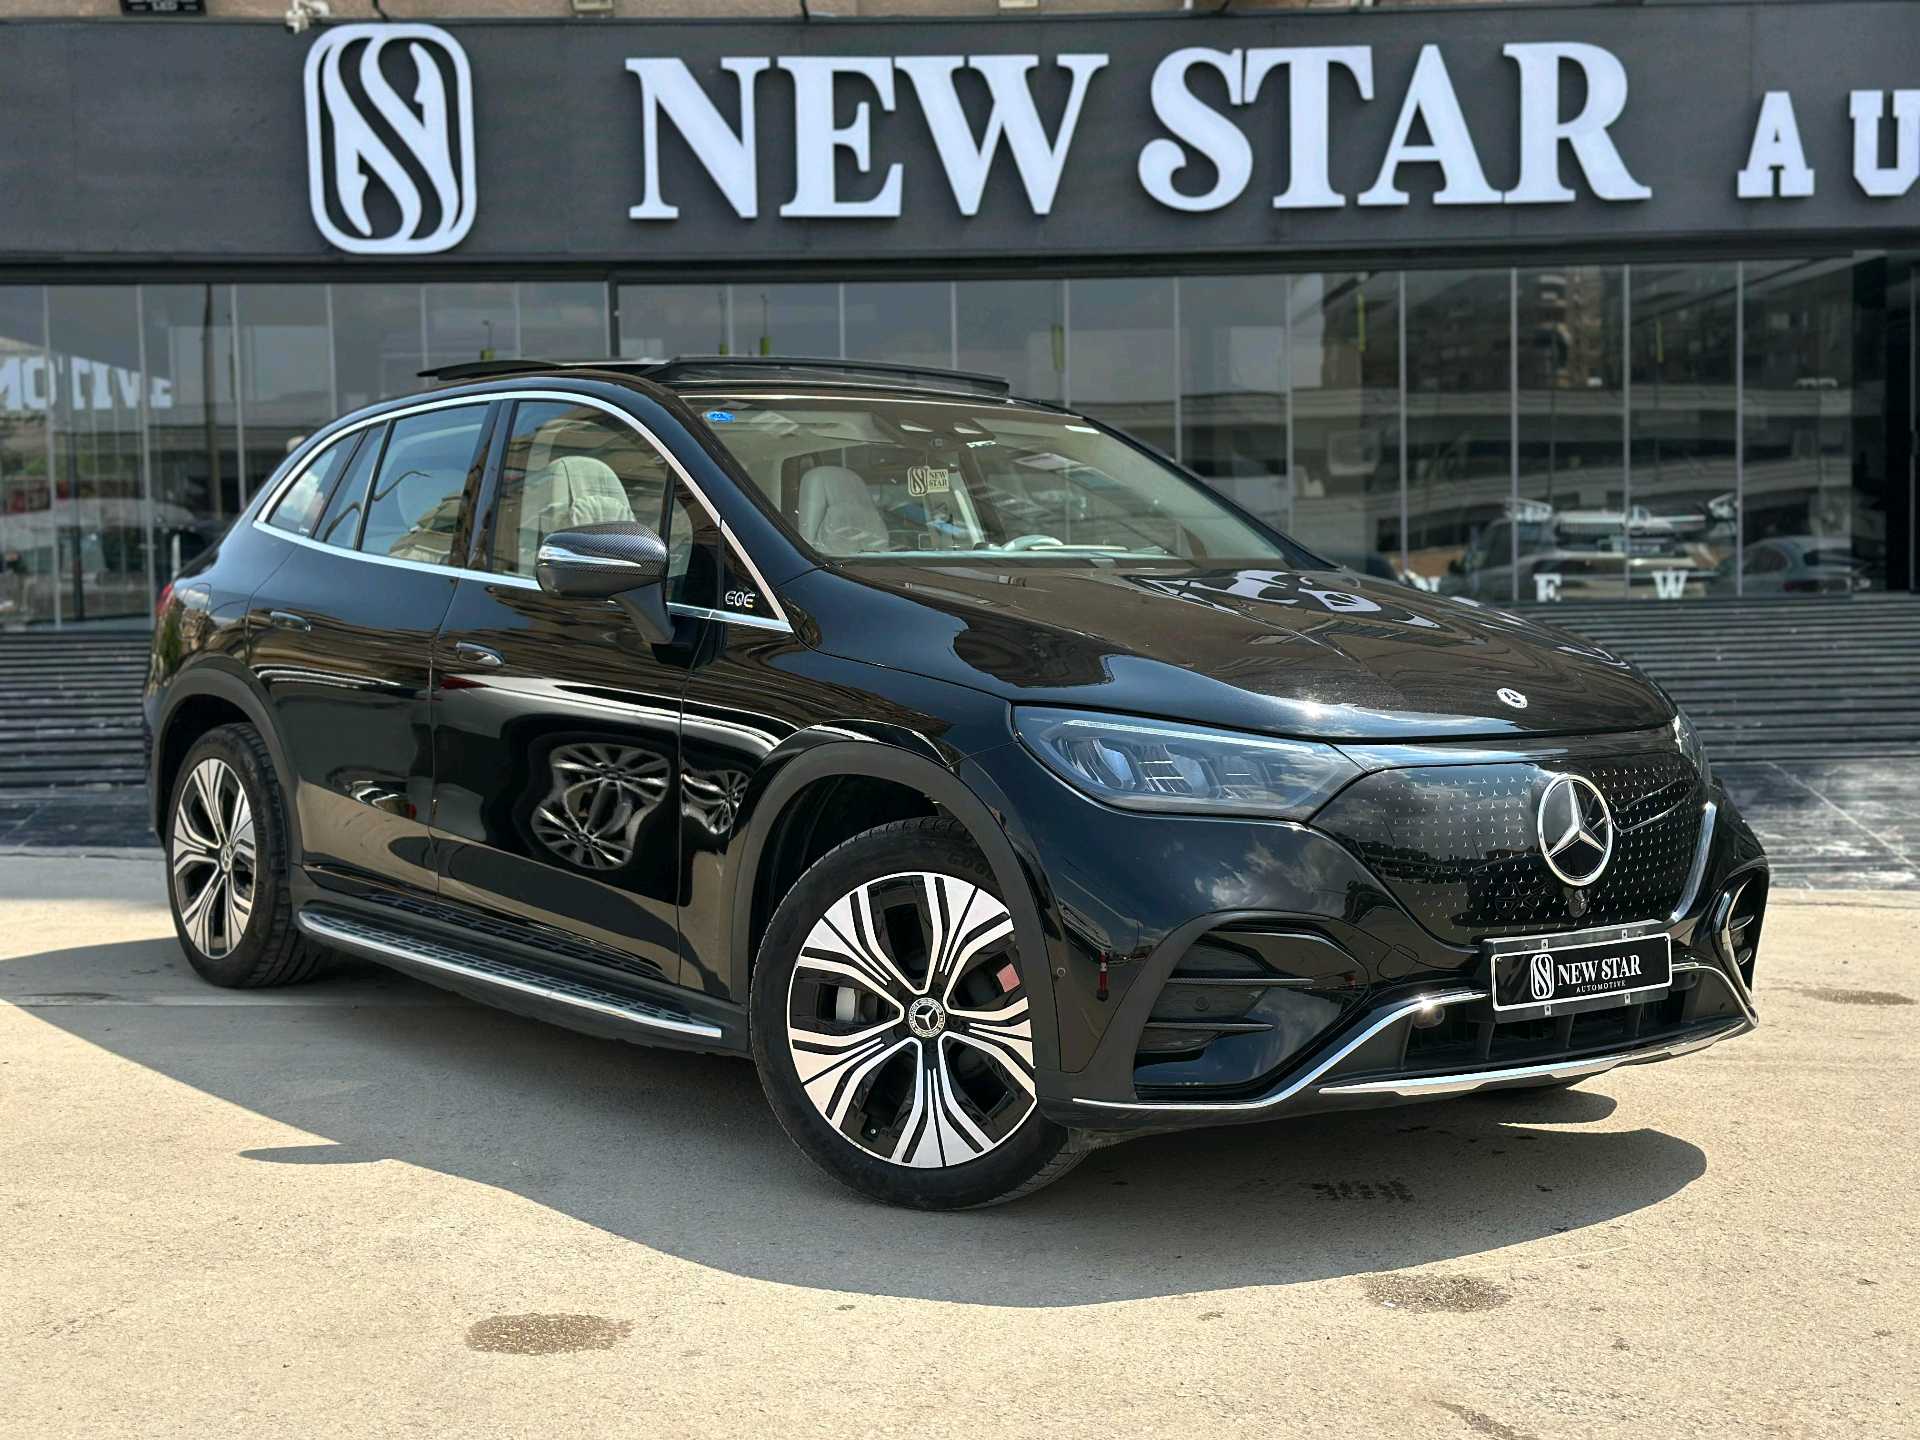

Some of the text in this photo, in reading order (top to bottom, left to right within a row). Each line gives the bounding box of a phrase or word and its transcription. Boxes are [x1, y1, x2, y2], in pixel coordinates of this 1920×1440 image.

[625, 54, 1109, 219] NEW
[1138, 42, 1653, 211] STAR
[929, 471, 947, 480] NEW
[929, 479, 948, 487] STAR
[726, 590, 756, 609] EQE
[1557, 955, 1642, 986] NEW STAR
[1576, 981, 1626, 993] AUTOMOTIVE
